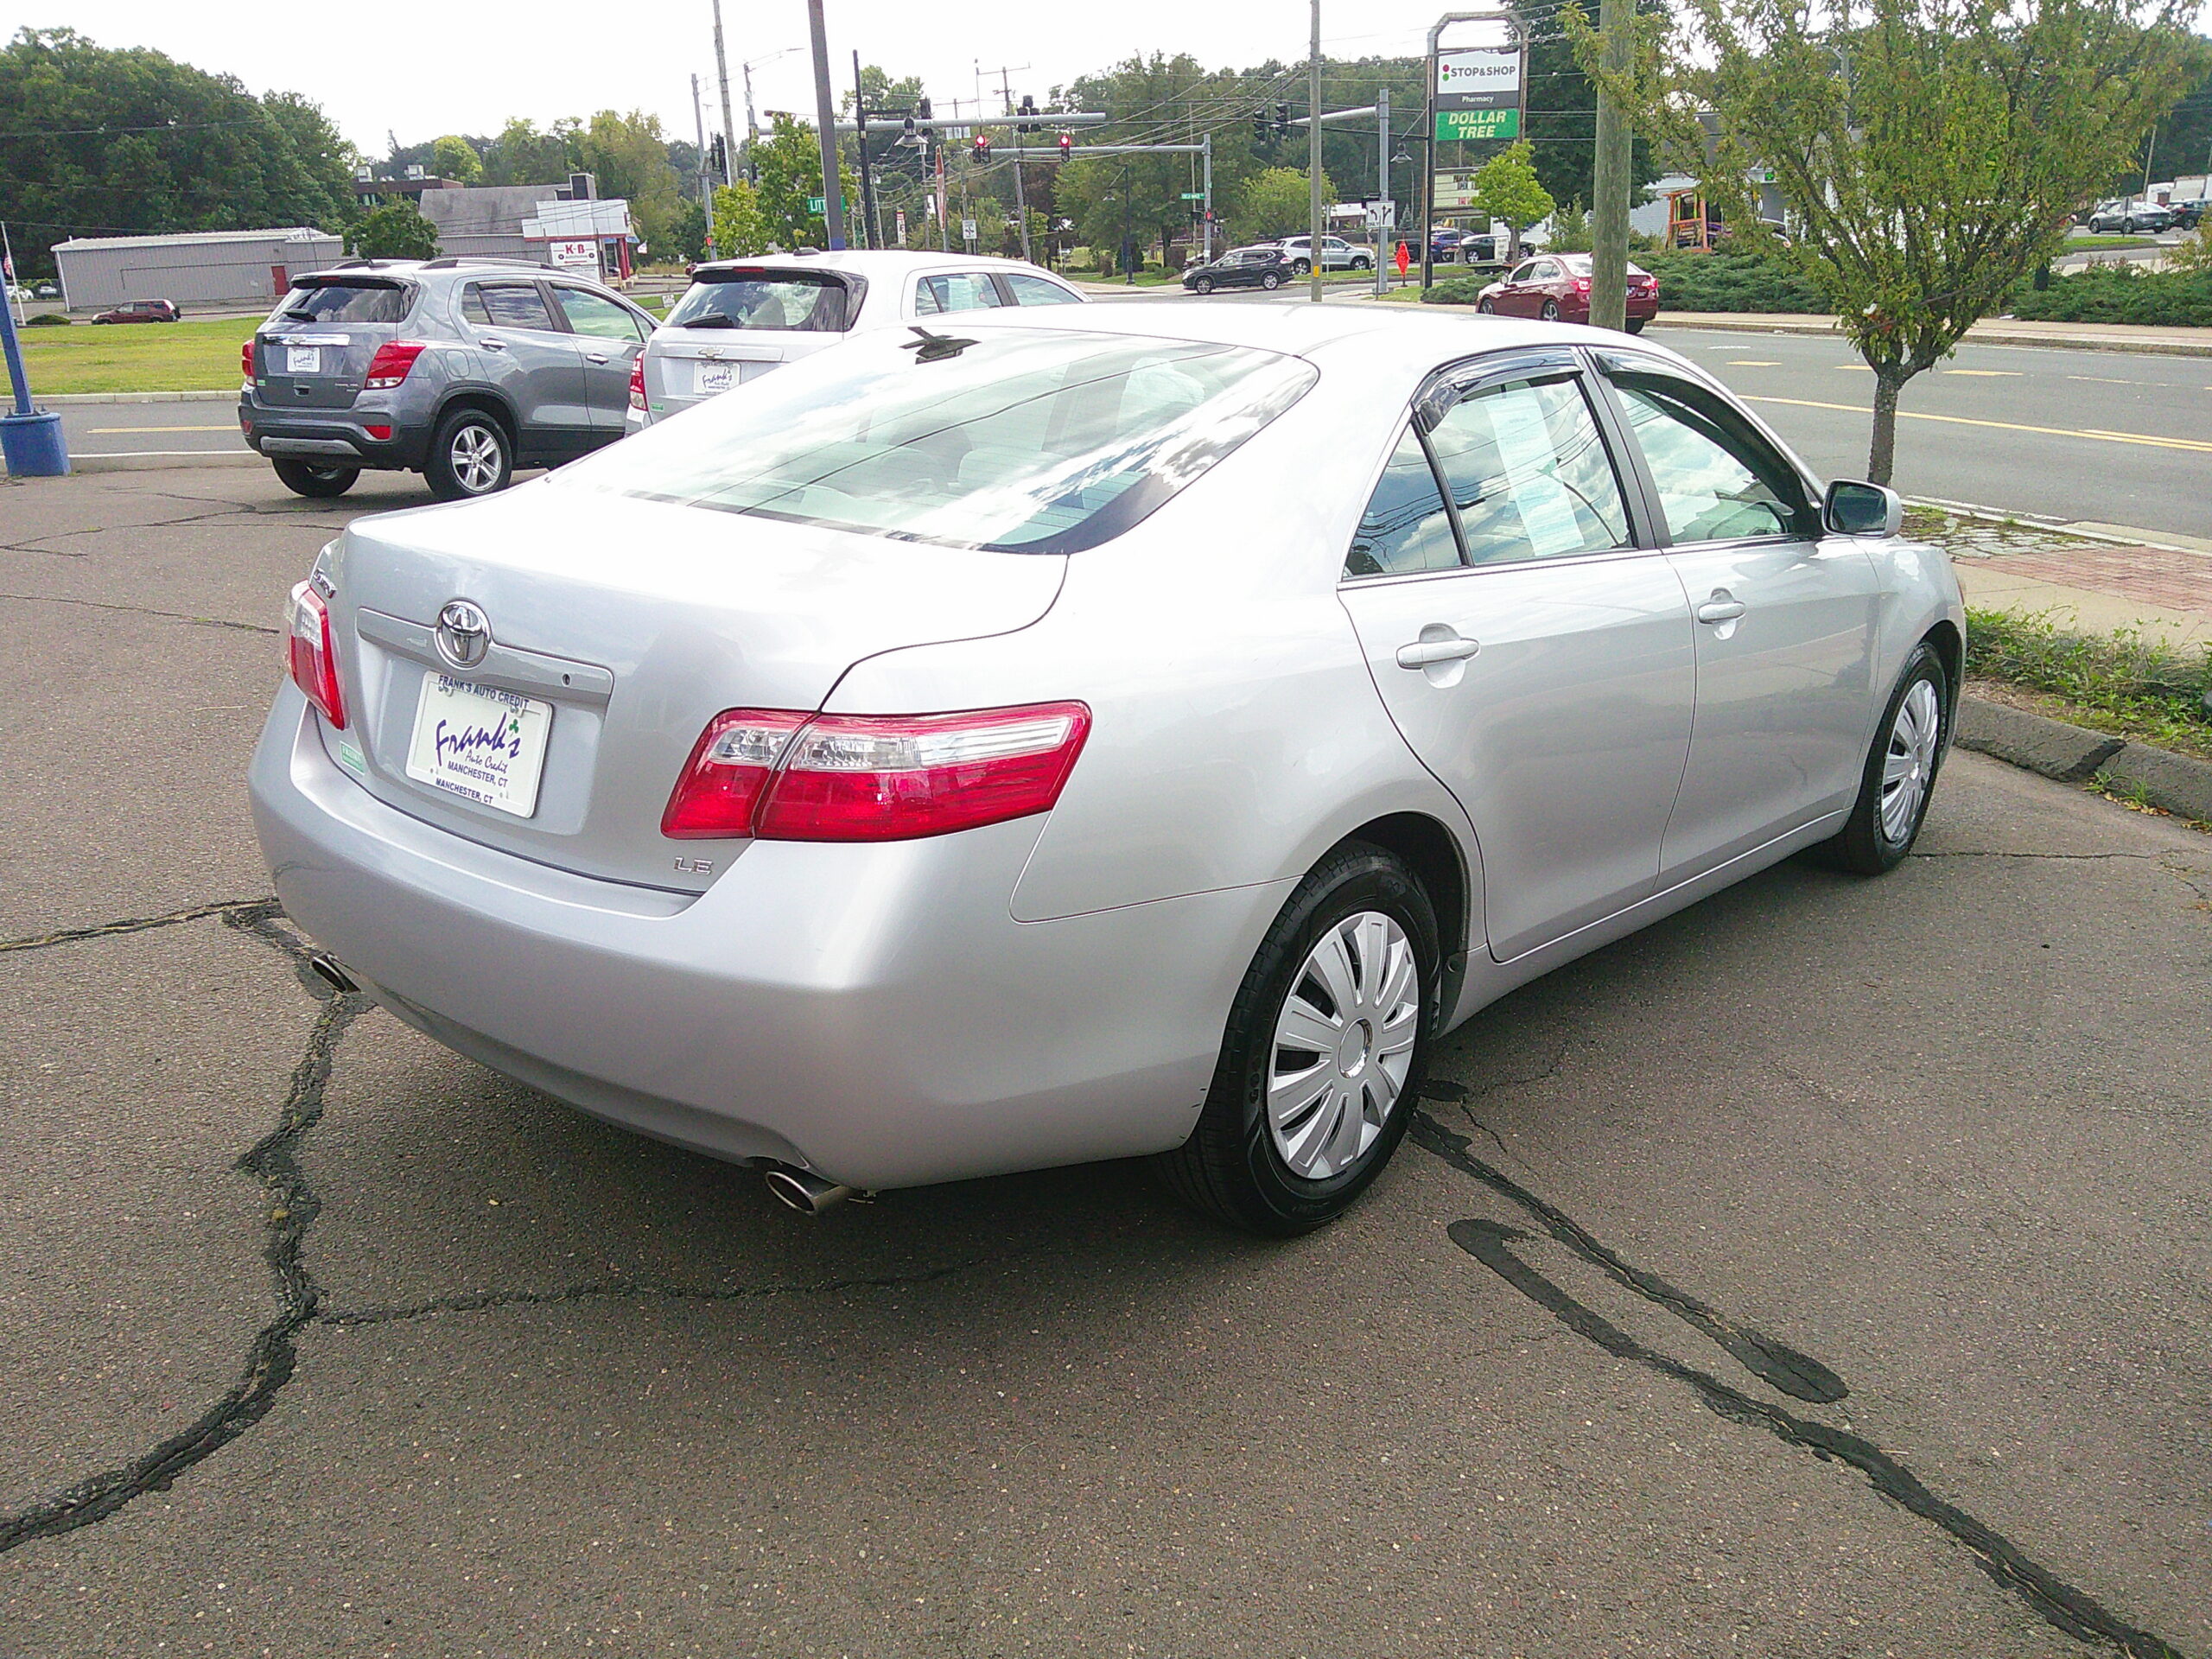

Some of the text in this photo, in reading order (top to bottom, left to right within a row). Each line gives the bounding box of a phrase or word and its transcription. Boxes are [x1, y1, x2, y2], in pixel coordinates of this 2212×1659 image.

[1451, 66, 1516, 77] STOP&SHOP
[1461, 95, 1494, 104] Pharmacy
[1448, 111, 1507, 125] DOLLAR
[1458, 124, 1497, 139] TREE
[438, 675, 530, 709] FRANK'S AUTO CREDIT
[435, 711, 521, 767] Frank's
[465, 749, 509, 774] Auto Credit
[448, 760, 508, 788] MANCHESTER, CT
[435, 777, 494, 804] MANCHESTER, CT
[674, 856, 713, 875] LE
